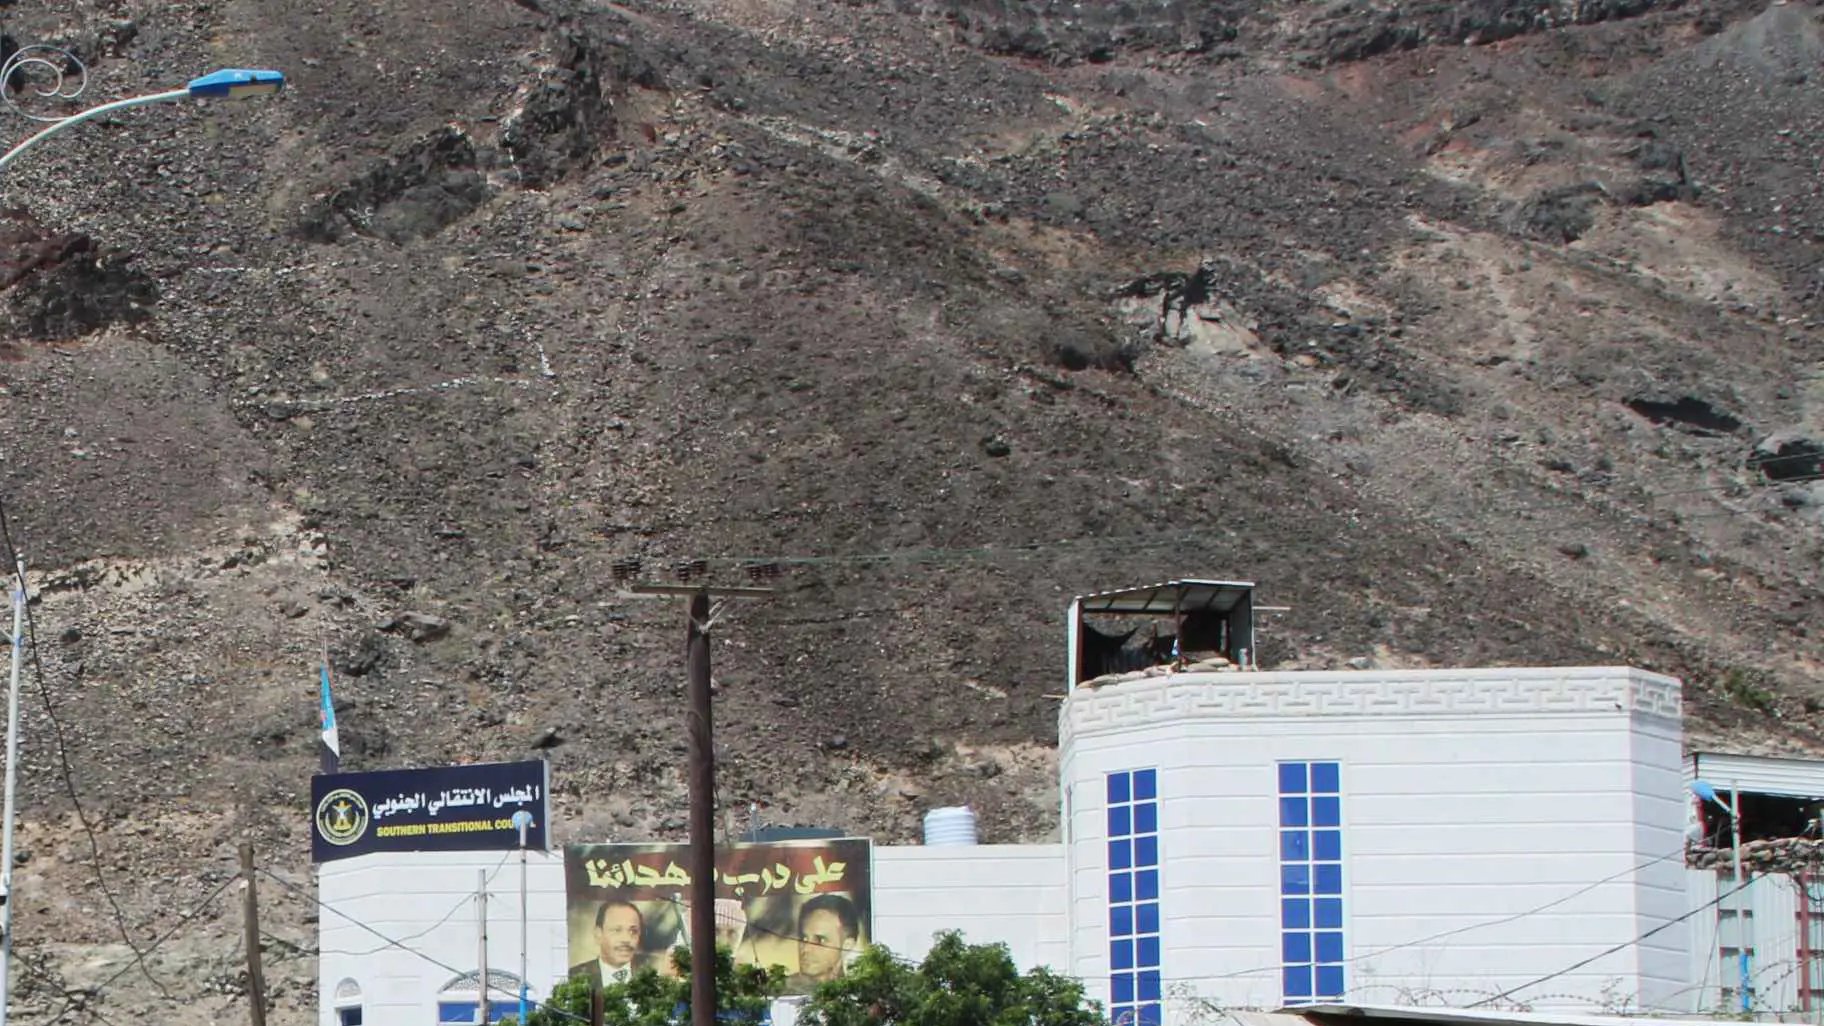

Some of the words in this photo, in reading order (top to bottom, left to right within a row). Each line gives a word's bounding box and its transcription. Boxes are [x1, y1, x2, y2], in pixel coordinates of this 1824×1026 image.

[372, 792, 426, 819] الجنوبي
[428, 788, 491, 816] الانتقالي
[493, 784, 539, 808] المجلس
[376, 823, 426, 837] SOUTHERN
[427, 820, 494, 834] TRANSITIONAL
[494, 818, 537, 830] COUL
[585, 858, 718, 889] هدائنا
[722, 862, 791, 897] درب
